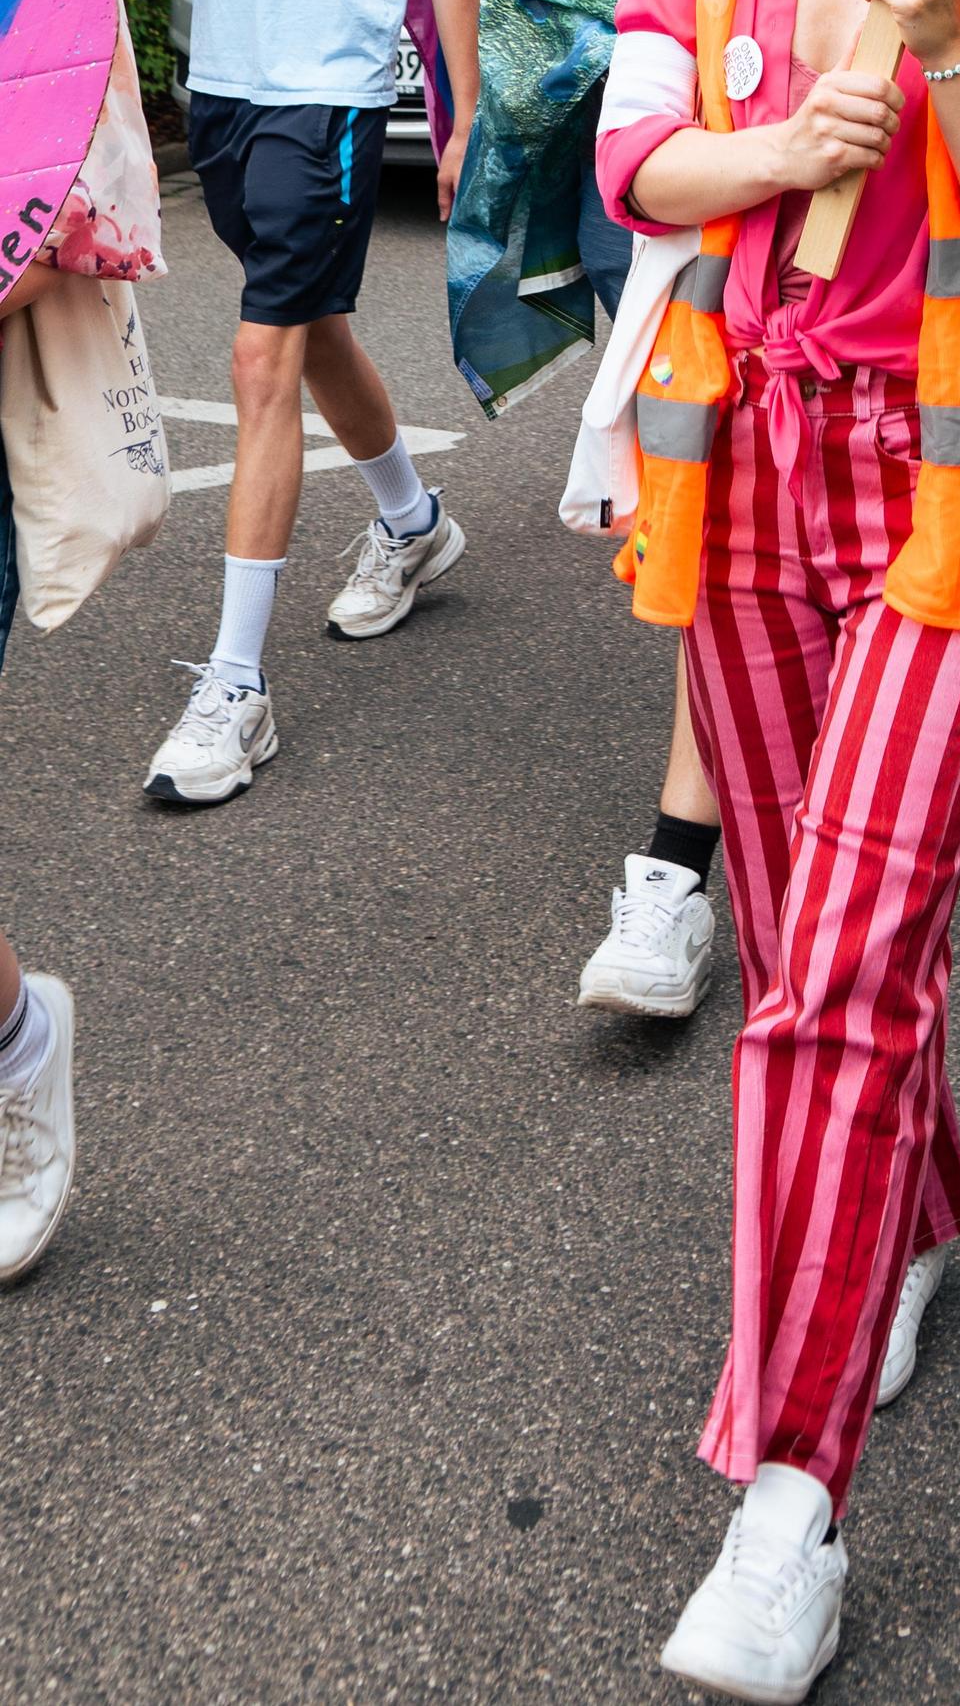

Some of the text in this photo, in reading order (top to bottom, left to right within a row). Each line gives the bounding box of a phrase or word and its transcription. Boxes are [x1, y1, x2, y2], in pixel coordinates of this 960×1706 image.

[723, 52, 743, 95] RECHTS
[731, 47, 750, 86] GEGEN
[741, 42, 759, 77] OMAS
